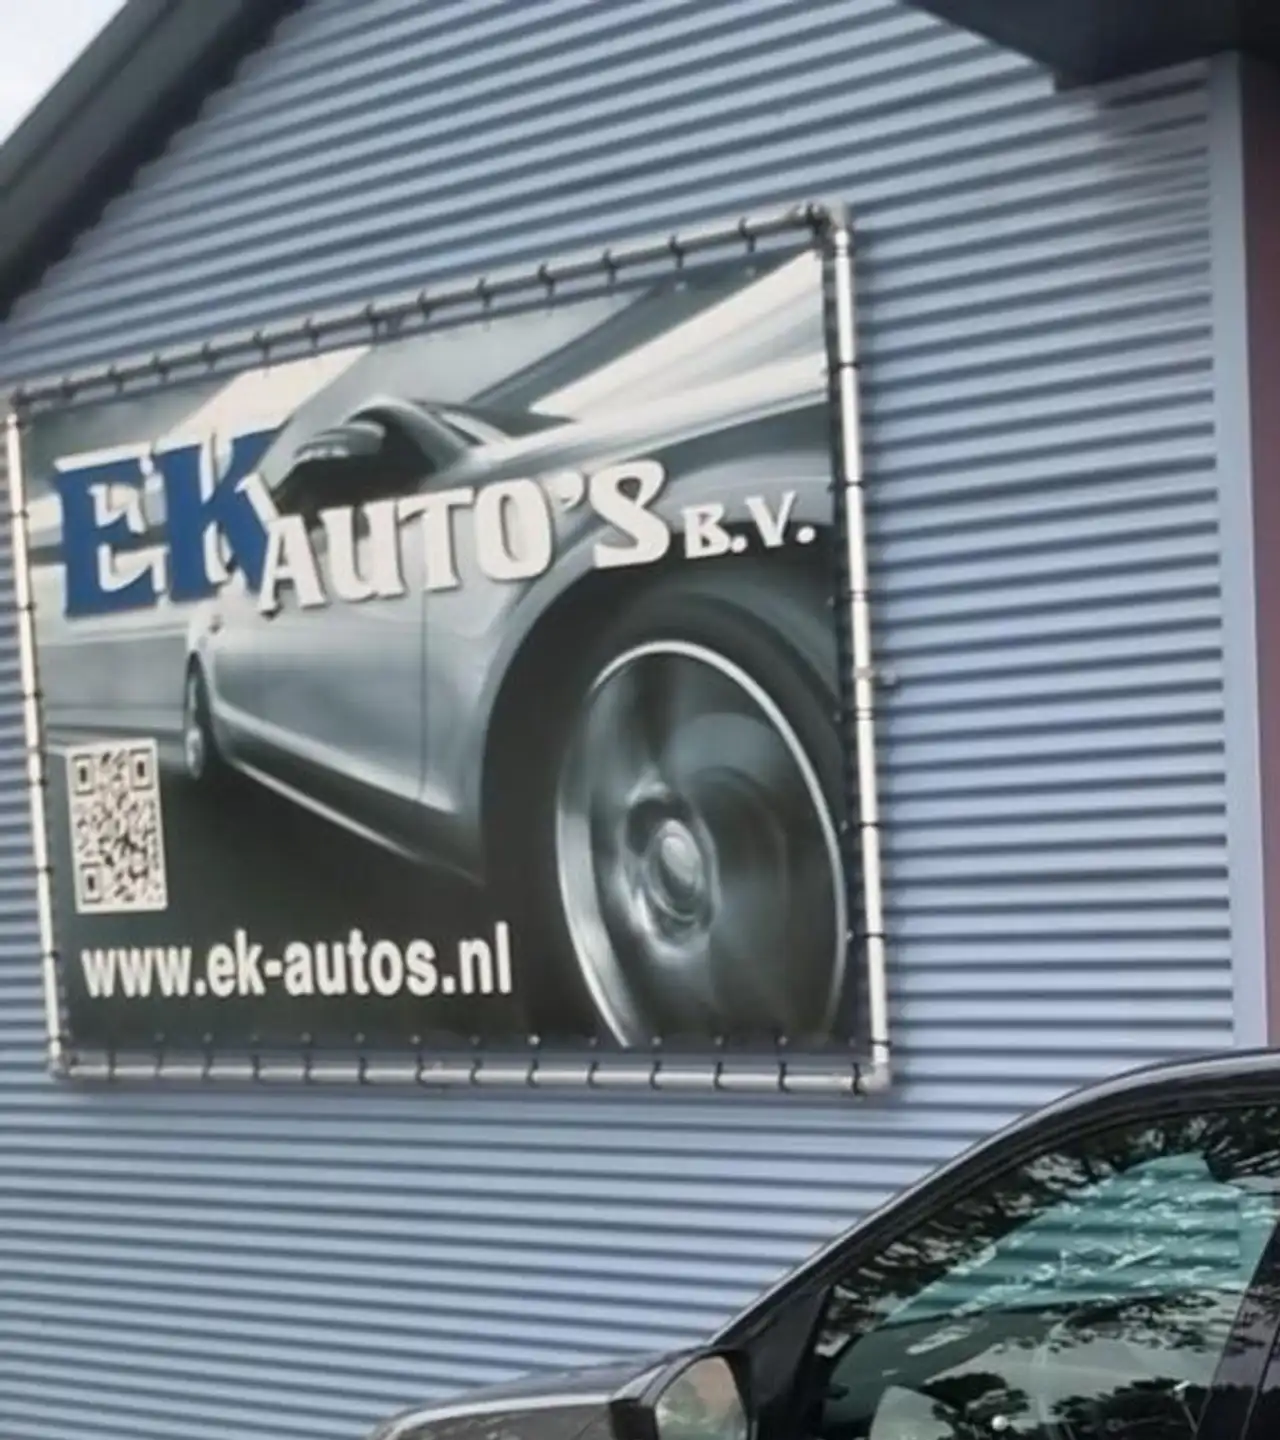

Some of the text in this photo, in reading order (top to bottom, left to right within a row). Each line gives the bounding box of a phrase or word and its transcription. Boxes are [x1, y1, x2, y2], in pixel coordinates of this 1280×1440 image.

[55, 423, 283, 621] EK
[681, 490, 817, 559] B.V.
[80, 919, 514, 999] www.ek-autos.nl
